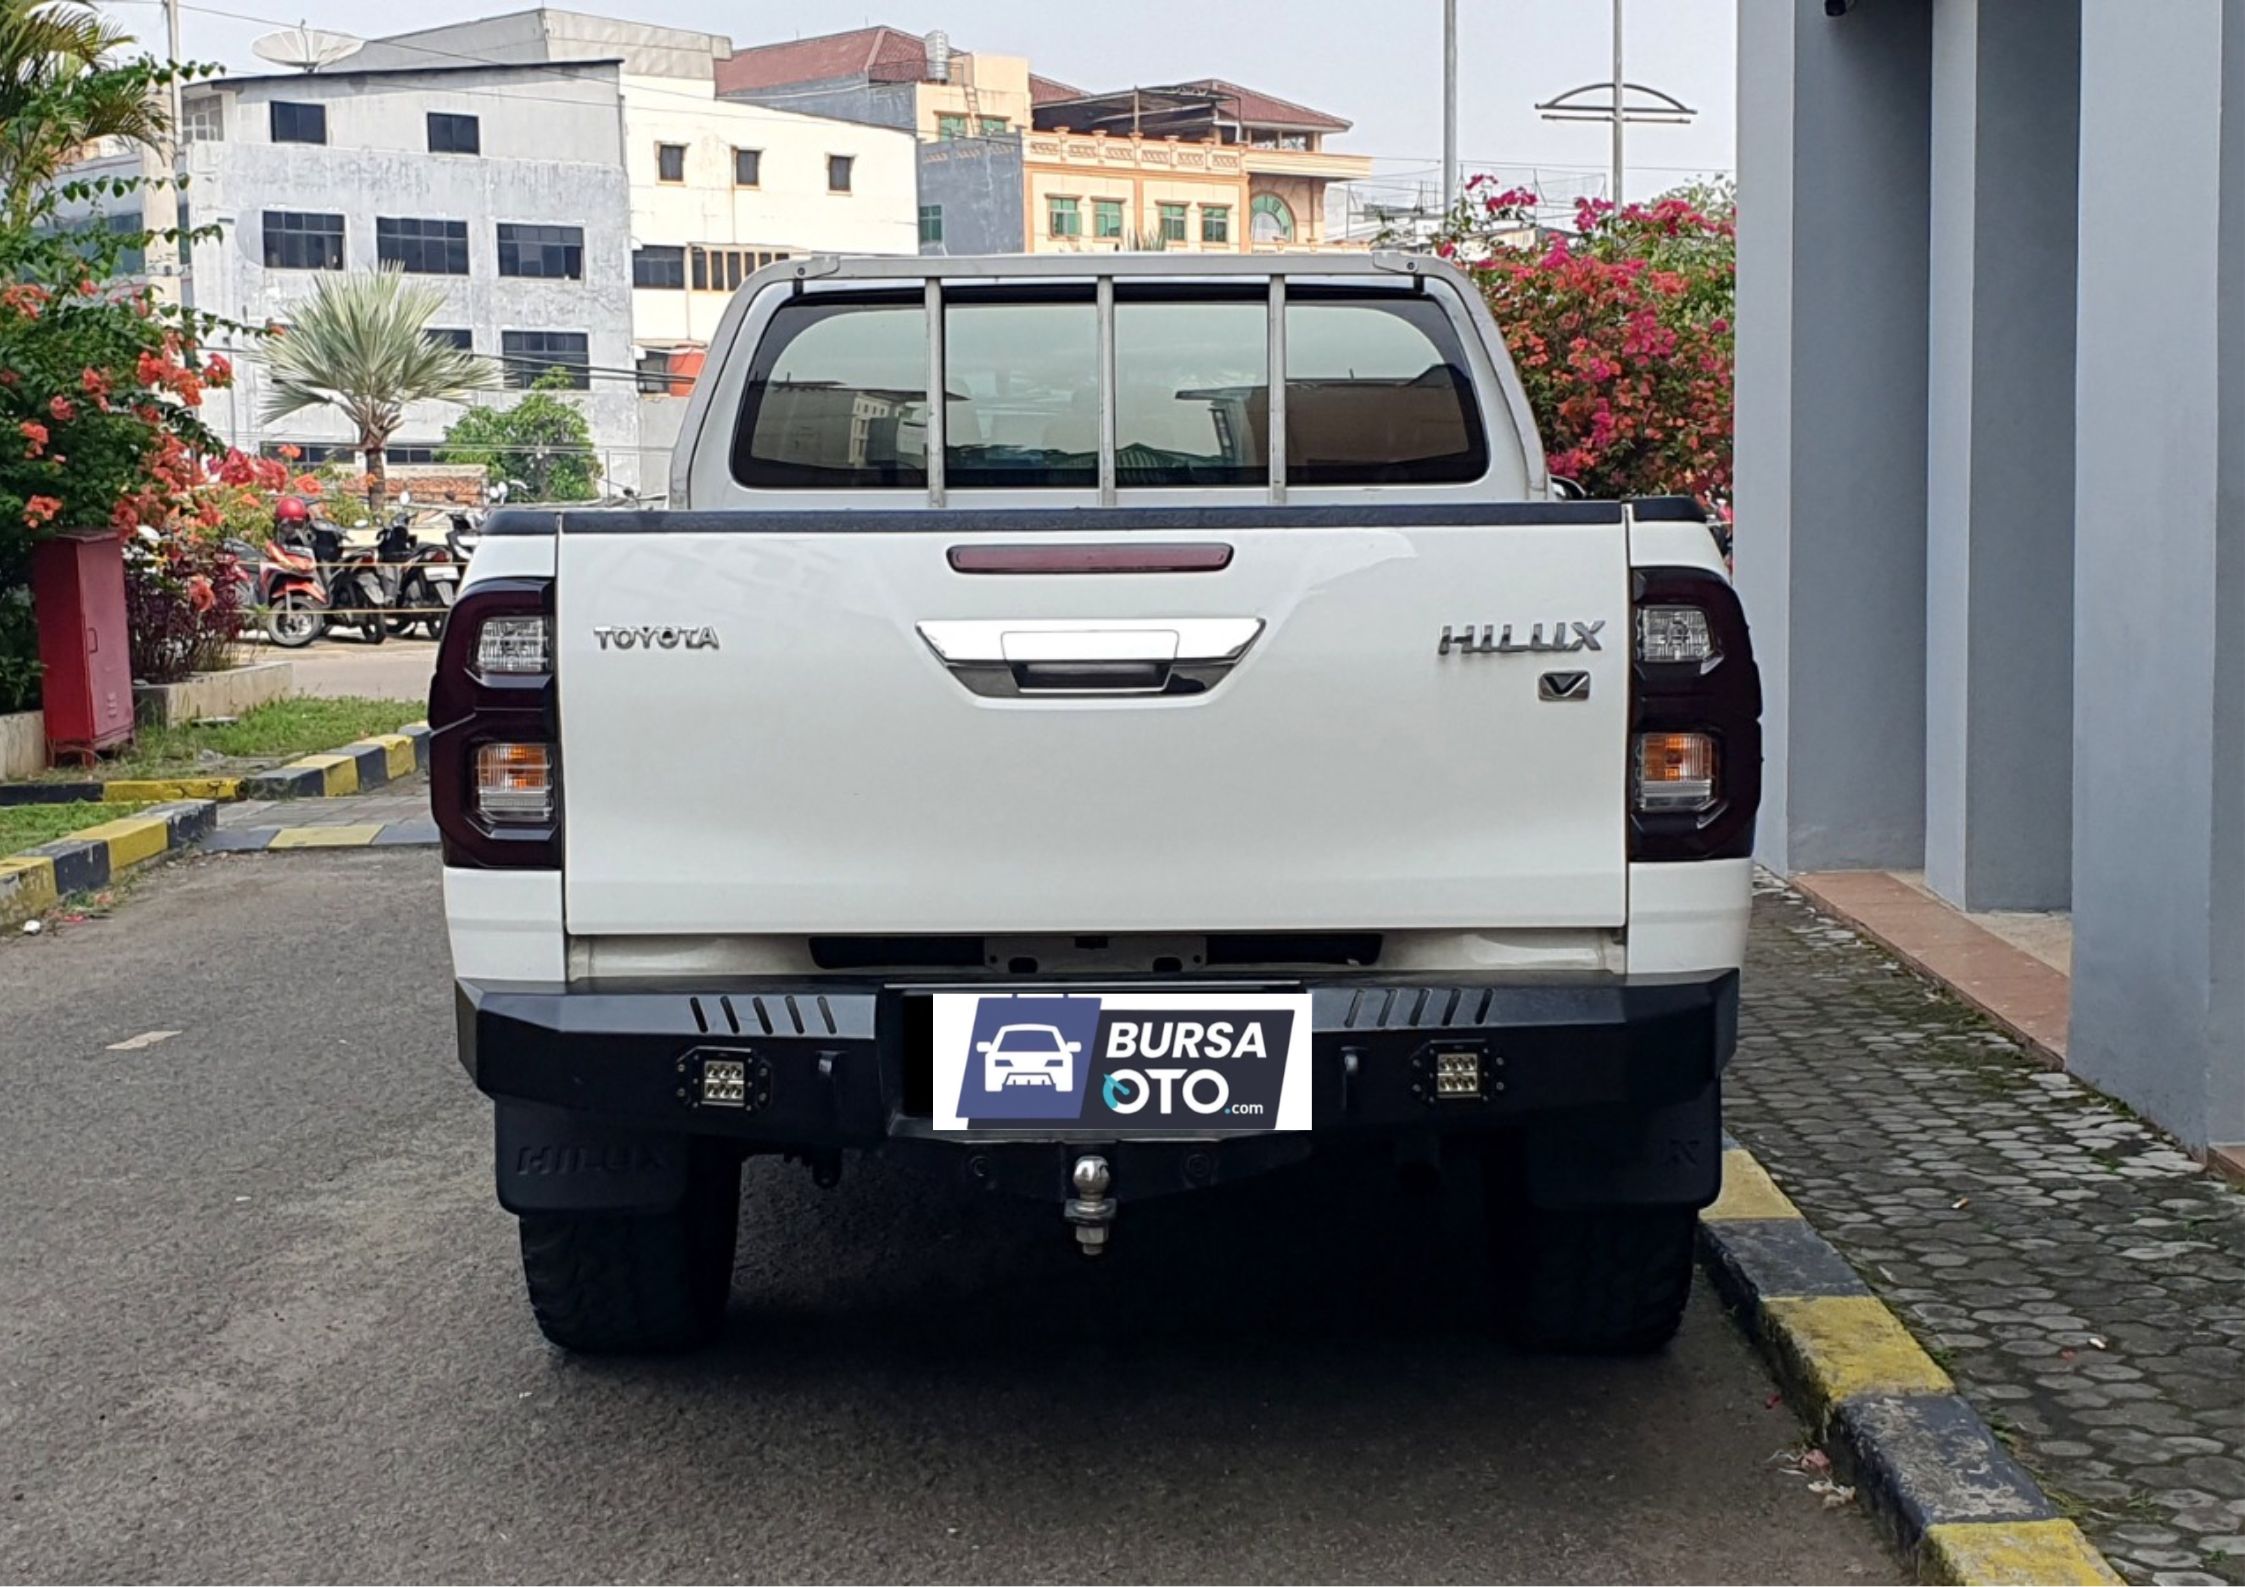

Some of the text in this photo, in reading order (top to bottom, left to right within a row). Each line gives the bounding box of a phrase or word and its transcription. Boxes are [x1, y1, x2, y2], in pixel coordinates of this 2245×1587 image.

[594, 626, 719, 650] TOYOTA
[1438, 620, 1606, 655] HILUX
[1541, 671, 1590, 698] V
